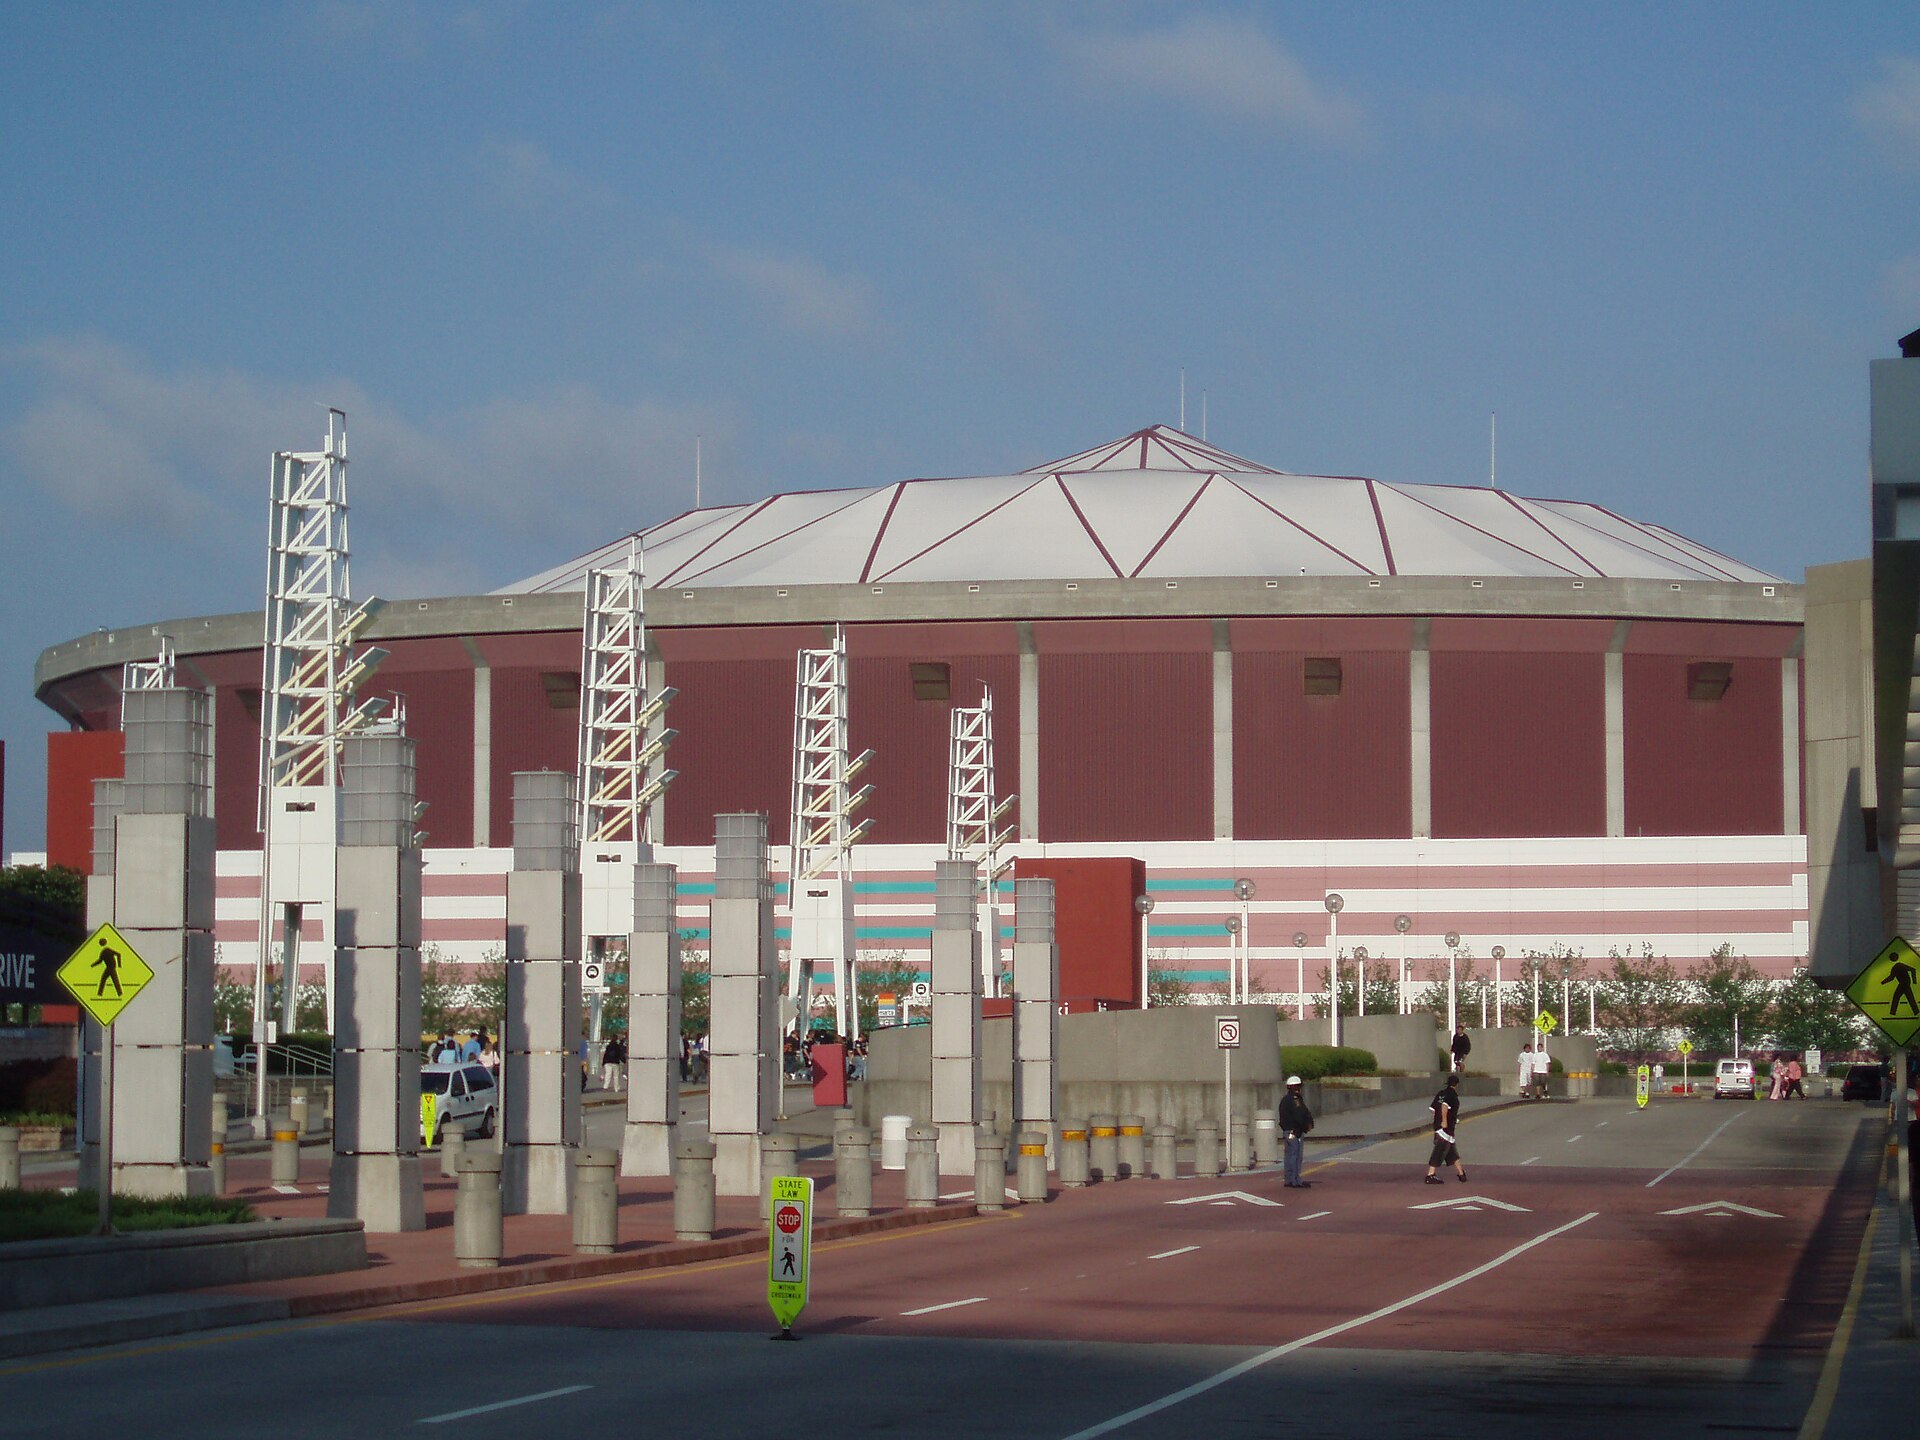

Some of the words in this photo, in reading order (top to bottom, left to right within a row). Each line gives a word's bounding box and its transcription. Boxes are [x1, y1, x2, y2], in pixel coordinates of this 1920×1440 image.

[778, 1179, 802, 1188] STATE
[781, 1190, 798, 1198] LAW
[778, 1214, 800, 1226] STOP
